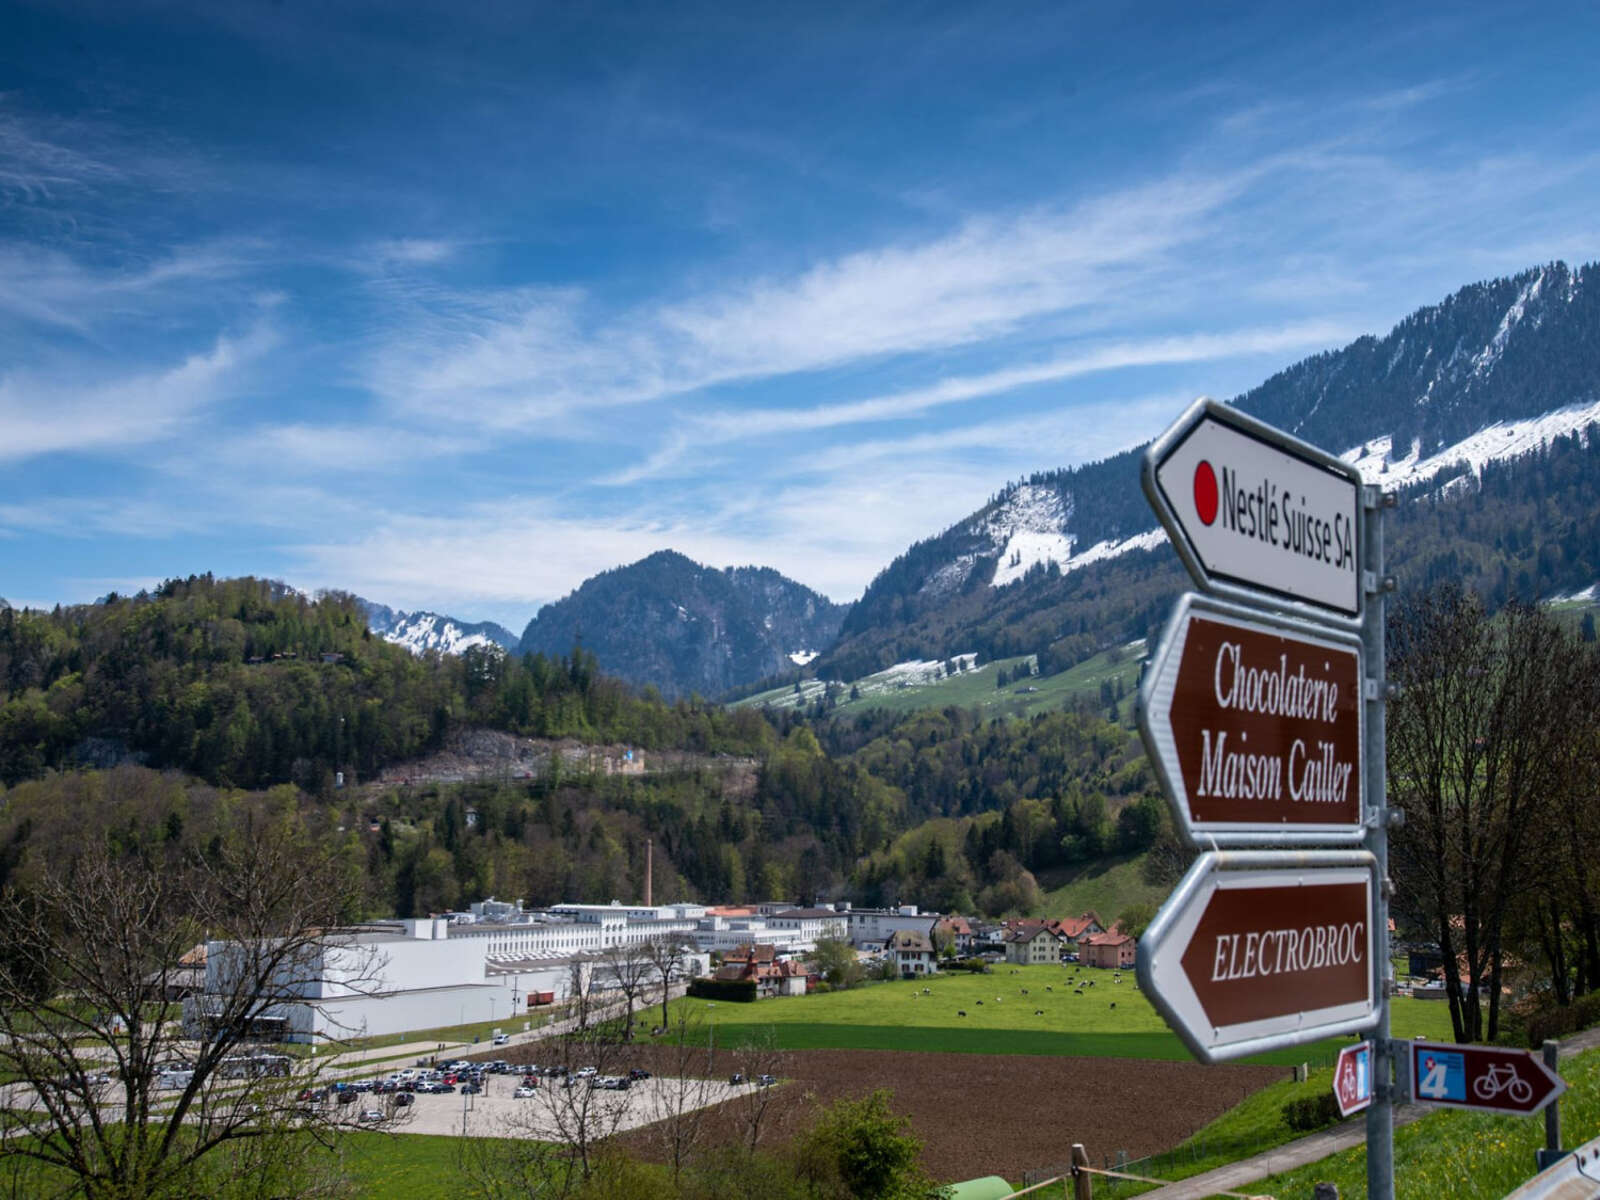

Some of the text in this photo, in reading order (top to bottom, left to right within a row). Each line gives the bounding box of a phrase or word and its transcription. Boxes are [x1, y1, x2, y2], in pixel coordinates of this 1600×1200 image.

[1222, 466, 1354, 572] Nestlé Suisse SA
[1214, 641, 1338, 723] Chocolaterie
[1197, 729, 1352, 802] Maison Cailler
[1211, 922, 1364, 982] ELECTROBROC
[1419, 1063, 1449, 1099] 4
